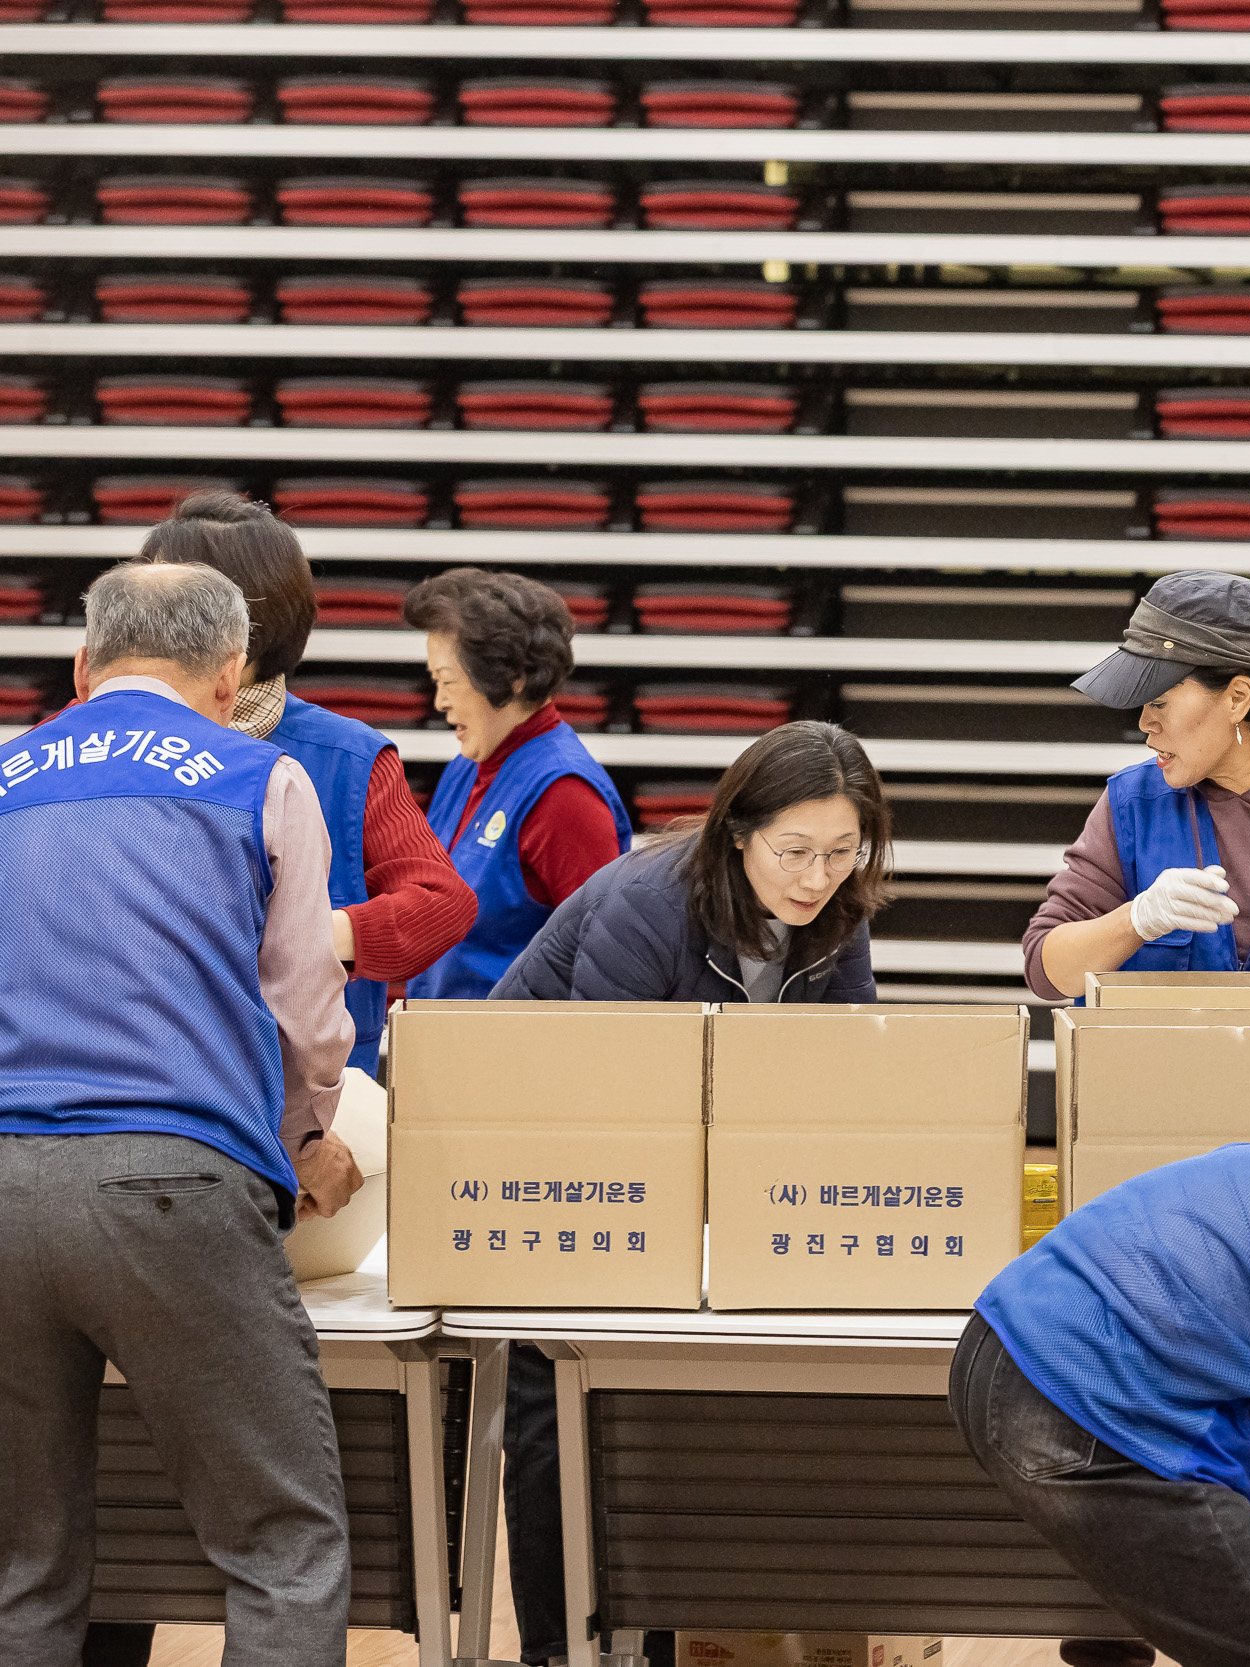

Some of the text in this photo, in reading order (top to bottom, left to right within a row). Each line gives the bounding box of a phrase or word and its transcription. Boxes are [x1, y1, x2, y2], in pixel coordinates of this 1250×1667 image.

[0, 730, 225, 797] 르게살기운동
[450, 1180, 647, 1204] (사) 바르게살기운동
[769, 1184, 964, 1208] (사) 바르게살기운동
